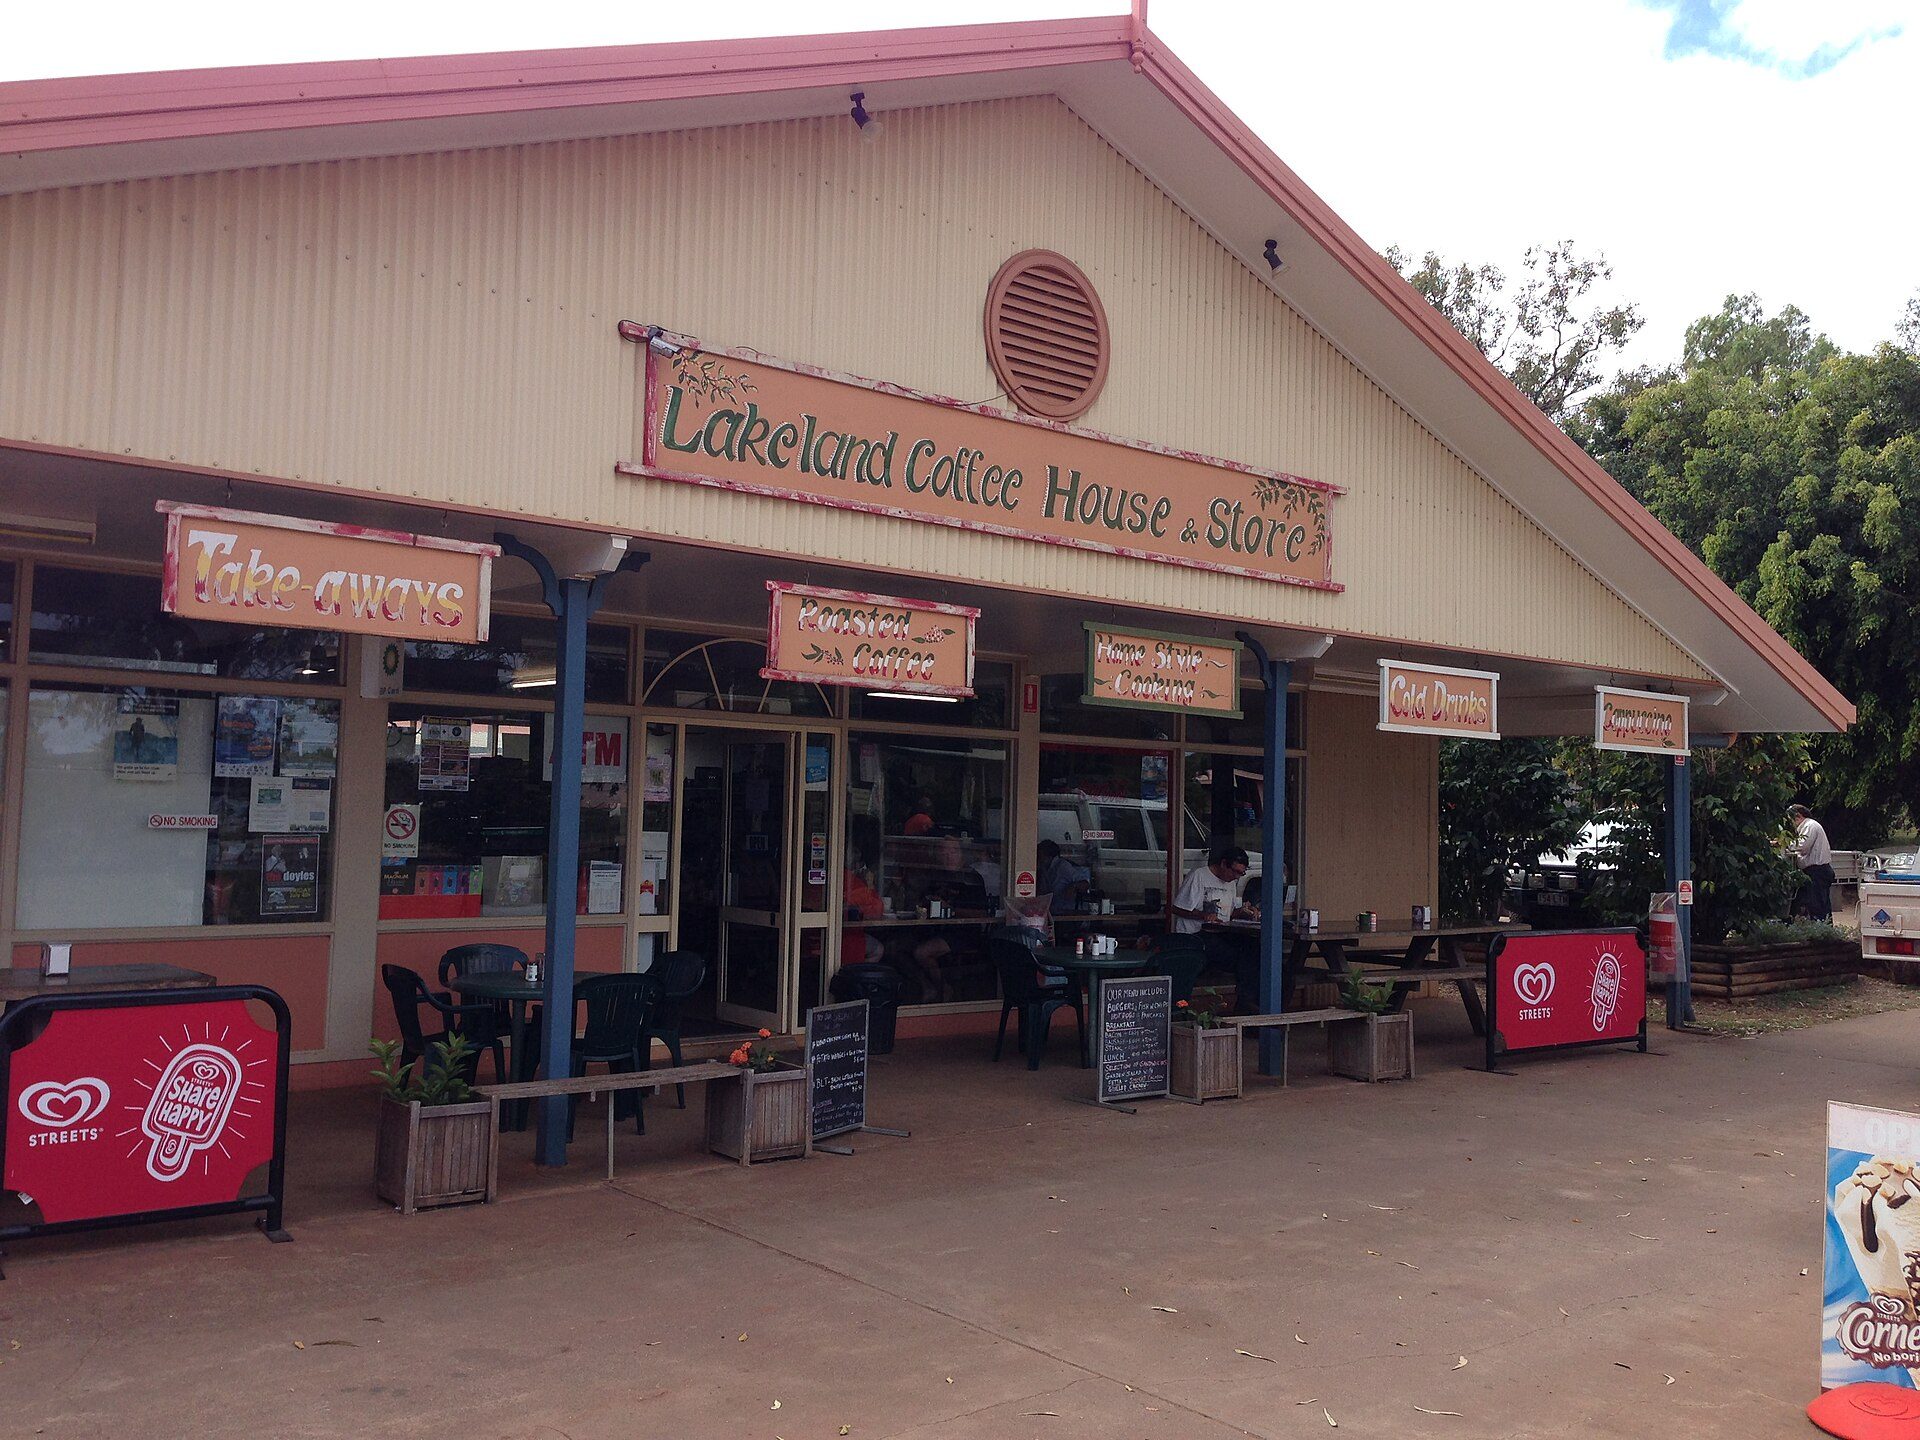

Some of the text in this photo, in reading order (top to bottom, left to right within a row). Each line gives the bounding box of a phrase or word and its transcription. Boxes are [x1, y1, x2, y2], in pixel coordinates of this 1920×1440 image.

[660, 385, 1306, 562] Lakeland Coffee House & Store
[187, 529, 464, 628] Take-aways
[798, 597, 911, 642] Roasted
[851, 642, 936, 681] Coffee
[1095, 633, 1203, 674] Home Style
[1112, 670, 1195, 706] Cooking
[1390, 674, 1488, 725] Cold Drinks
[163, 815, 217, 827] NO SMOKING
[283, 870, 315, 882] doyles
[1107, 988, 1122, 1001] OUR
[1518, 1007, 1551, 1021] STREETS
[1105, 1021, 1135, 1030] BREAKFAST
[1103, 1053, 1125, 1062] LUNCH
[28, 1128, 98, 1148] STREETS
[1876, 1312, 1901, 1323] STREETS
[1873, 1351, 1891, 1363] No
